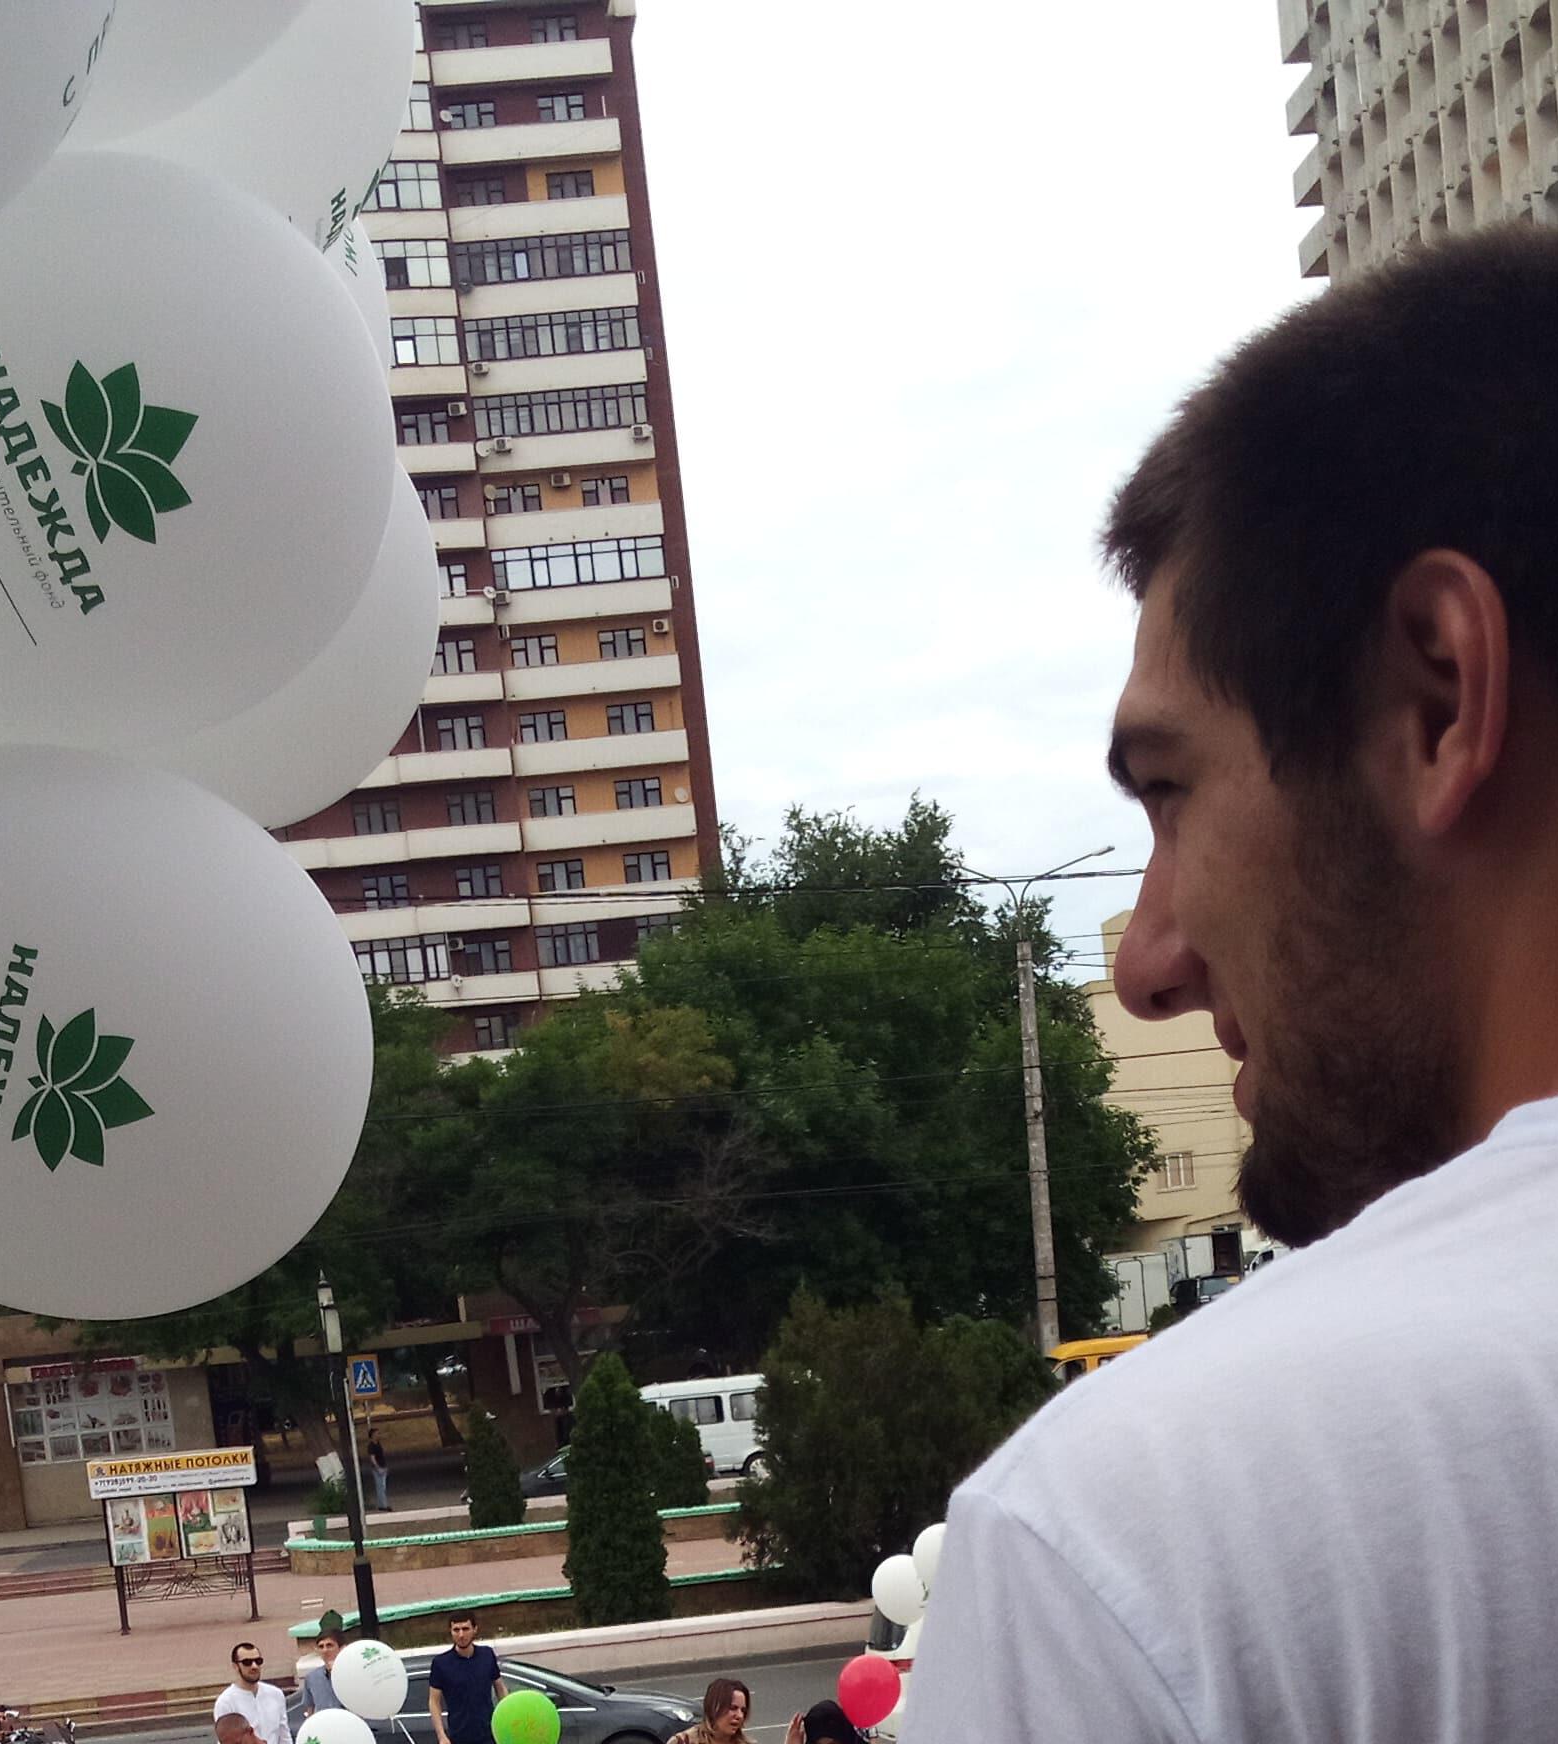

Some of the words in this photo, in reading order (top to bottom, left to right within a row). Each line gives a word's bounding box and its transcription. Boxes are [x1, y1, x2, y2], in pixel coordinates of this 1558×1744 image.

[33, 566, 65, 610] фонд
[109, 1458, 182, 1475] НАТЯЖНЫЕ
[186, 1453, 249, 1468] ПОТОЛКИ
